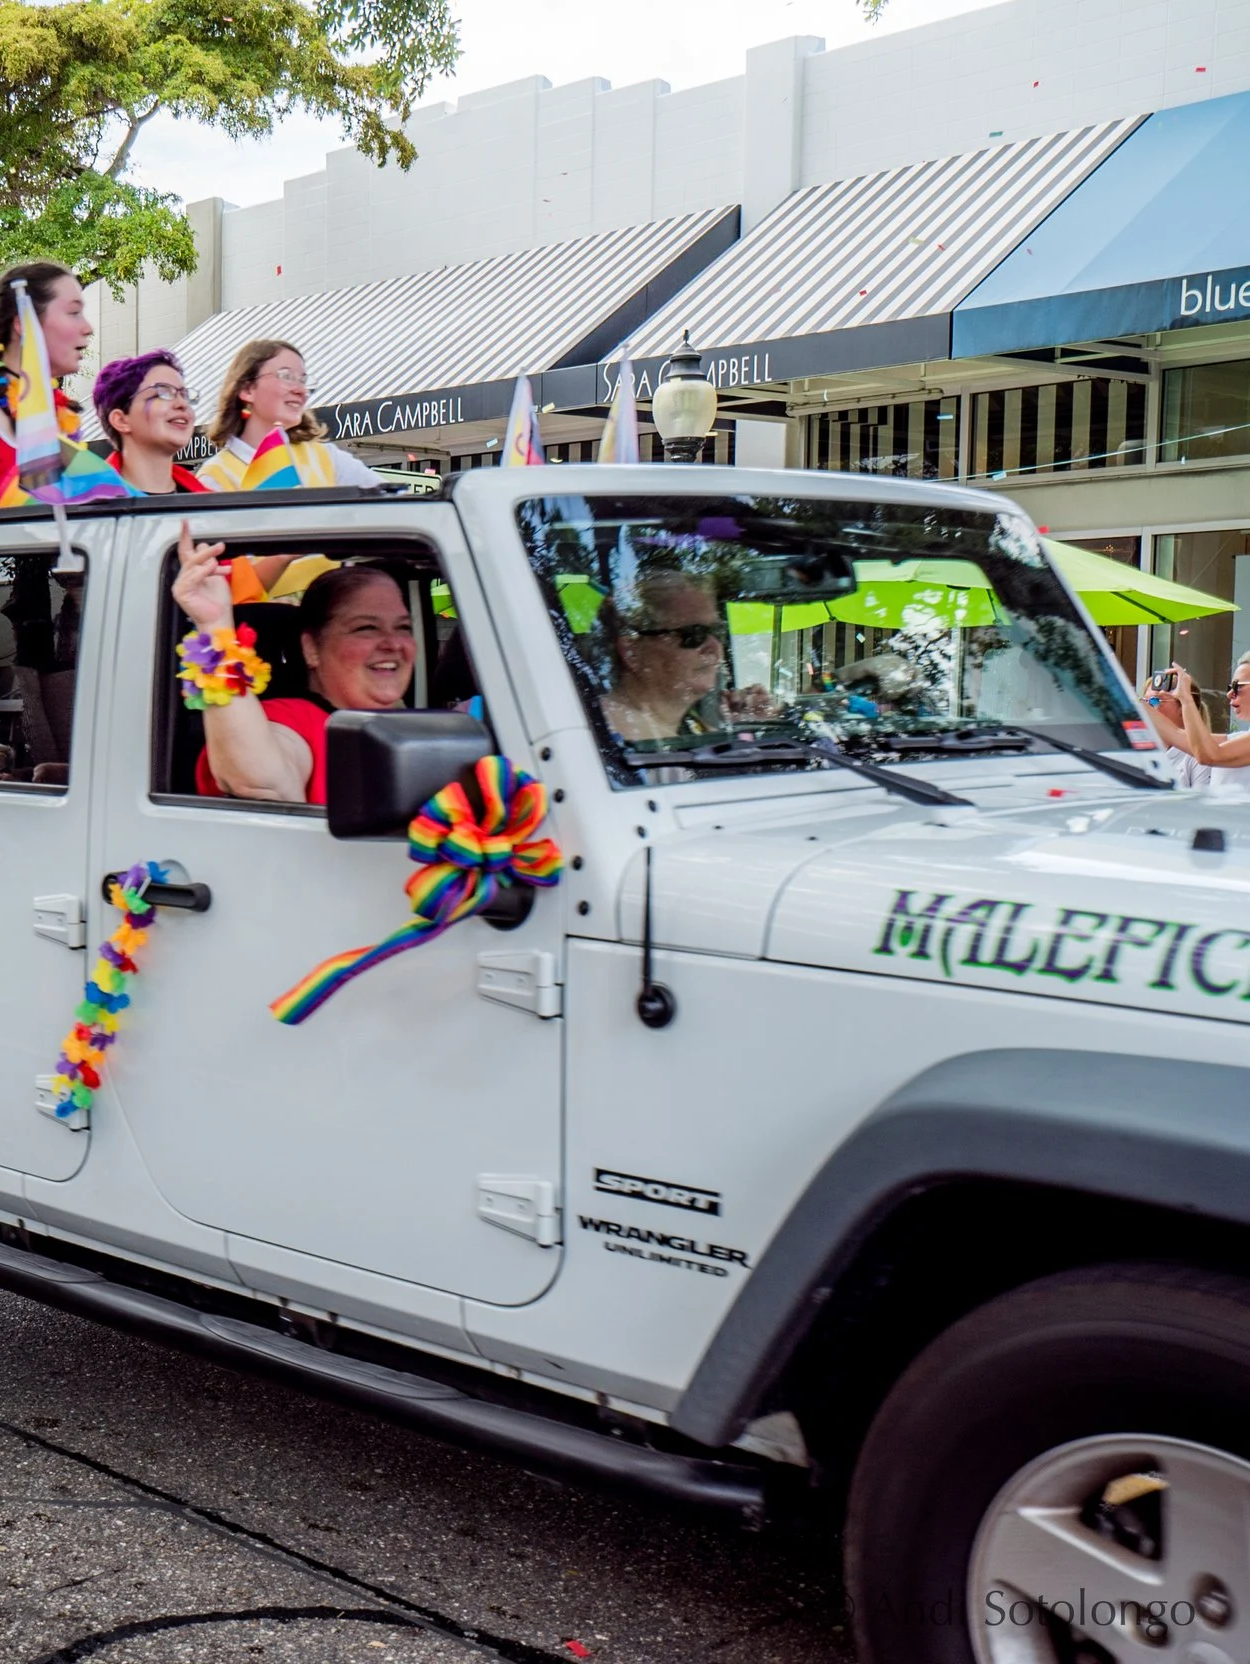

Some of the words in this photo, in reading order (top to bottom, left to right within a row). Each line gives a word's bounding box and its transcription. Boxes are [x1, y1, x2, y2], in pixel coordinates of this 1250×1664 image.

[335, 403, 373, 440] SARA
[377, 397, 464, 433] CAMPBELL
[871, 888, 1250, 1000] MALEFIC
[597, 1172, 717, 1211] SPORT
[577, 1214, 753, 1270] WRANGLER
[603, 1240, 730, 1278] UNLIMITED
